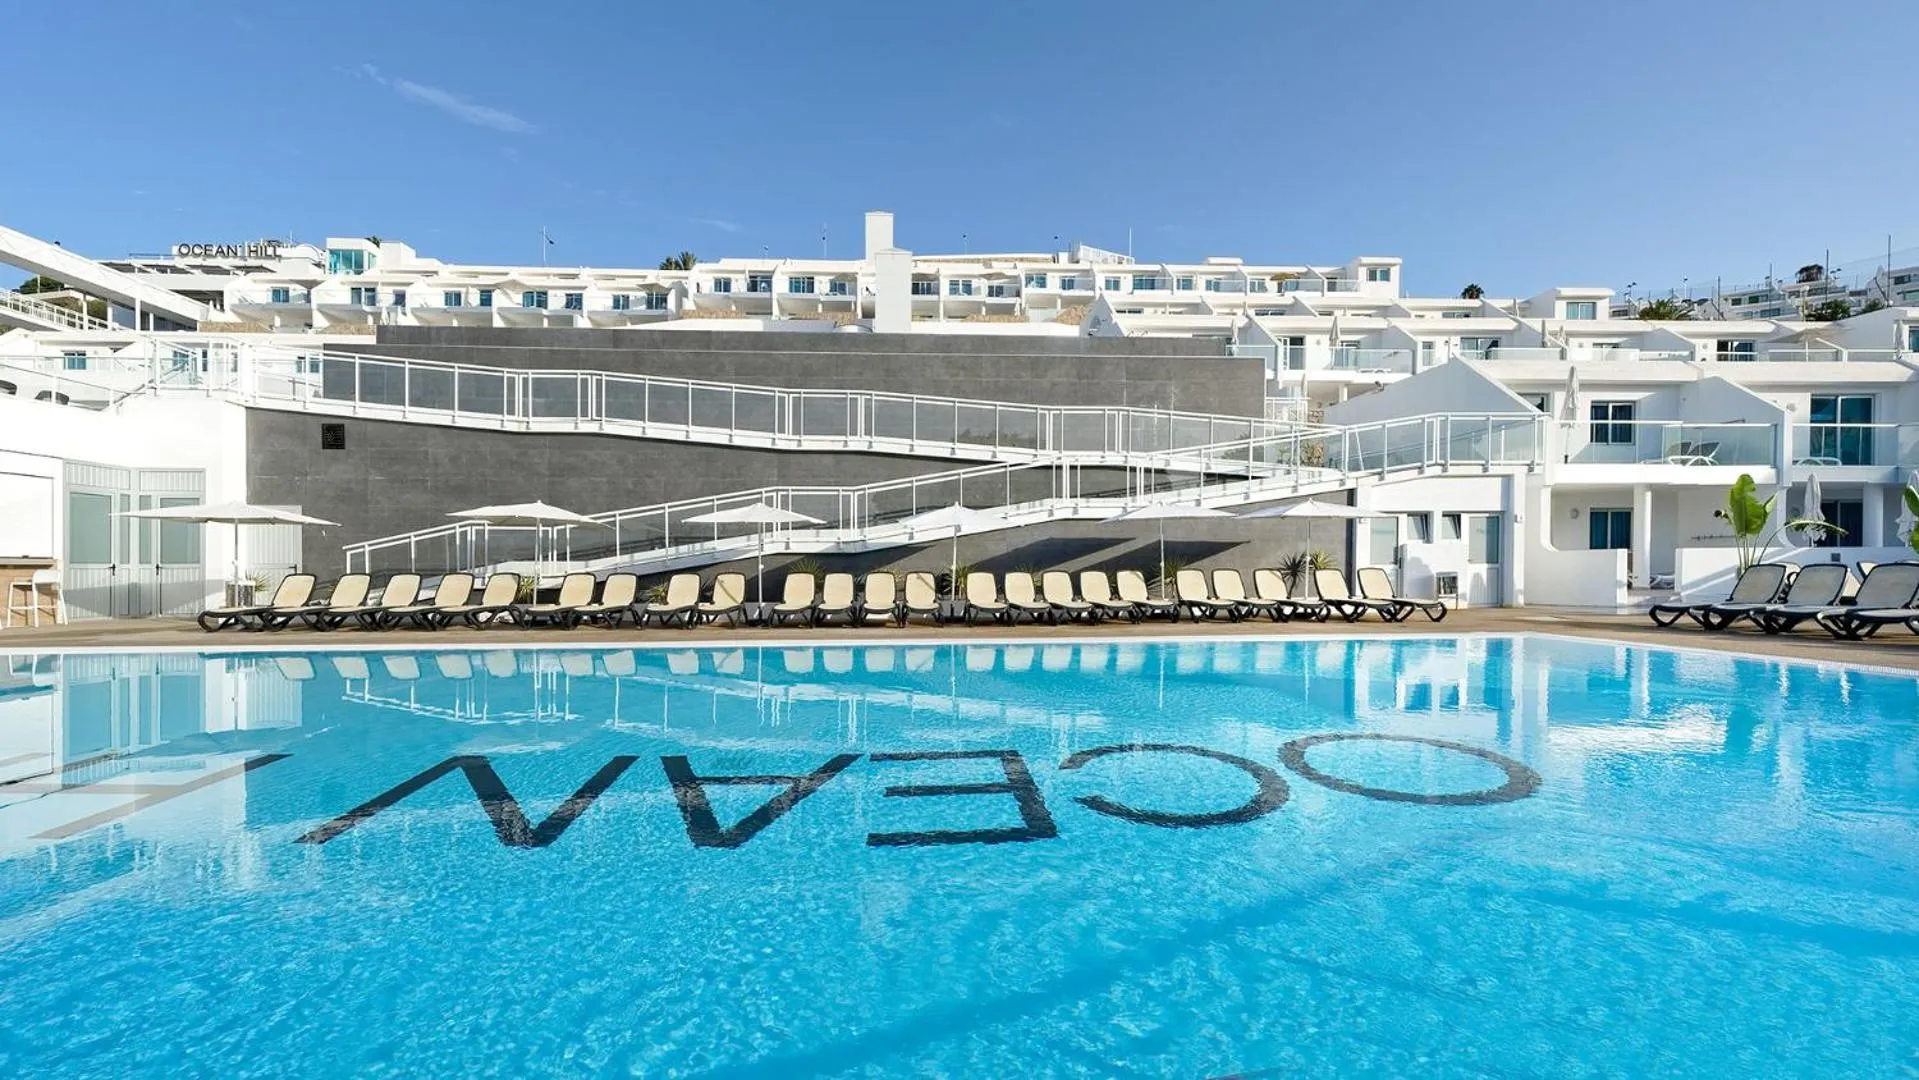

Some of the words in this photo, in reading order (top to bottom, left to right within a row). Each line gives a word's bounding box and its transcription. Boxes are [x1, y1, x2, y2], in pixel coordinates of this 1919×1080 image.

[178, 243, 238, 257] OCEAN
[248, 244, 282, 258] HILL
[295, 733, 1543, 848] OCEAN
